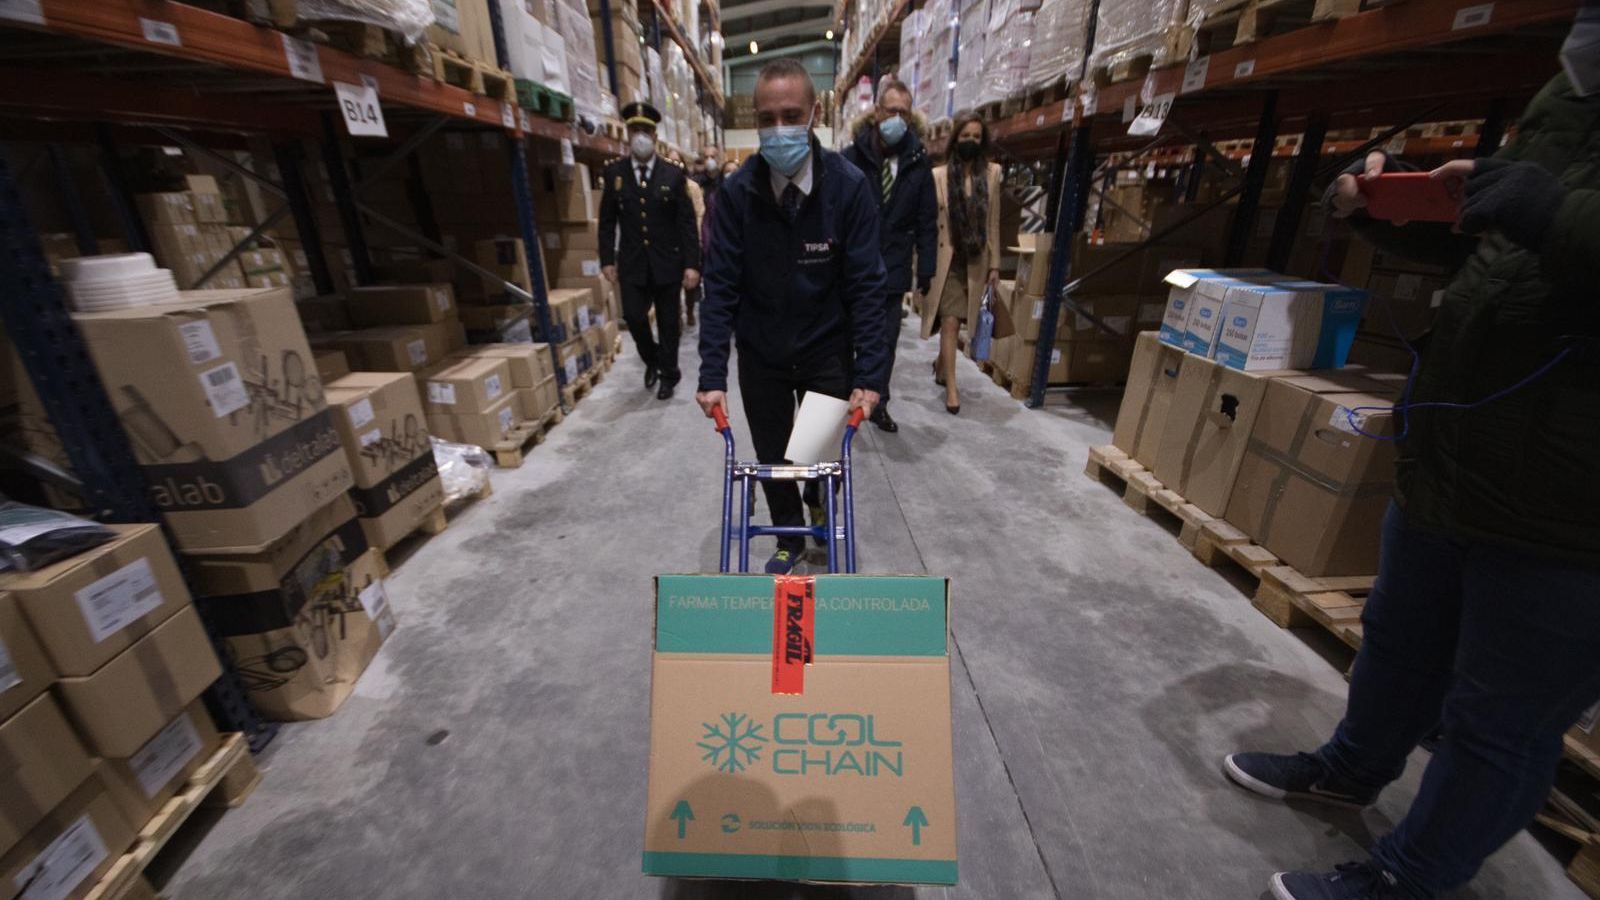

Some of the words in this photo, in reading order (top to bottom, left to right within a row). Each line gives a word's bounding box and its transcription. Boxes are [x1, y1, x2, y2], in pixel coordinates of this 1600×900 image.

[343, 98, 378, 125] B14
[151, 475, 225, 506] alab
[669, 595, 718, 610] FARMA
[830, 596, 930, 612] CONTROLADA
[773, 713, 903, 747] COOL
[772, 749, 904, 777] CHAIN
